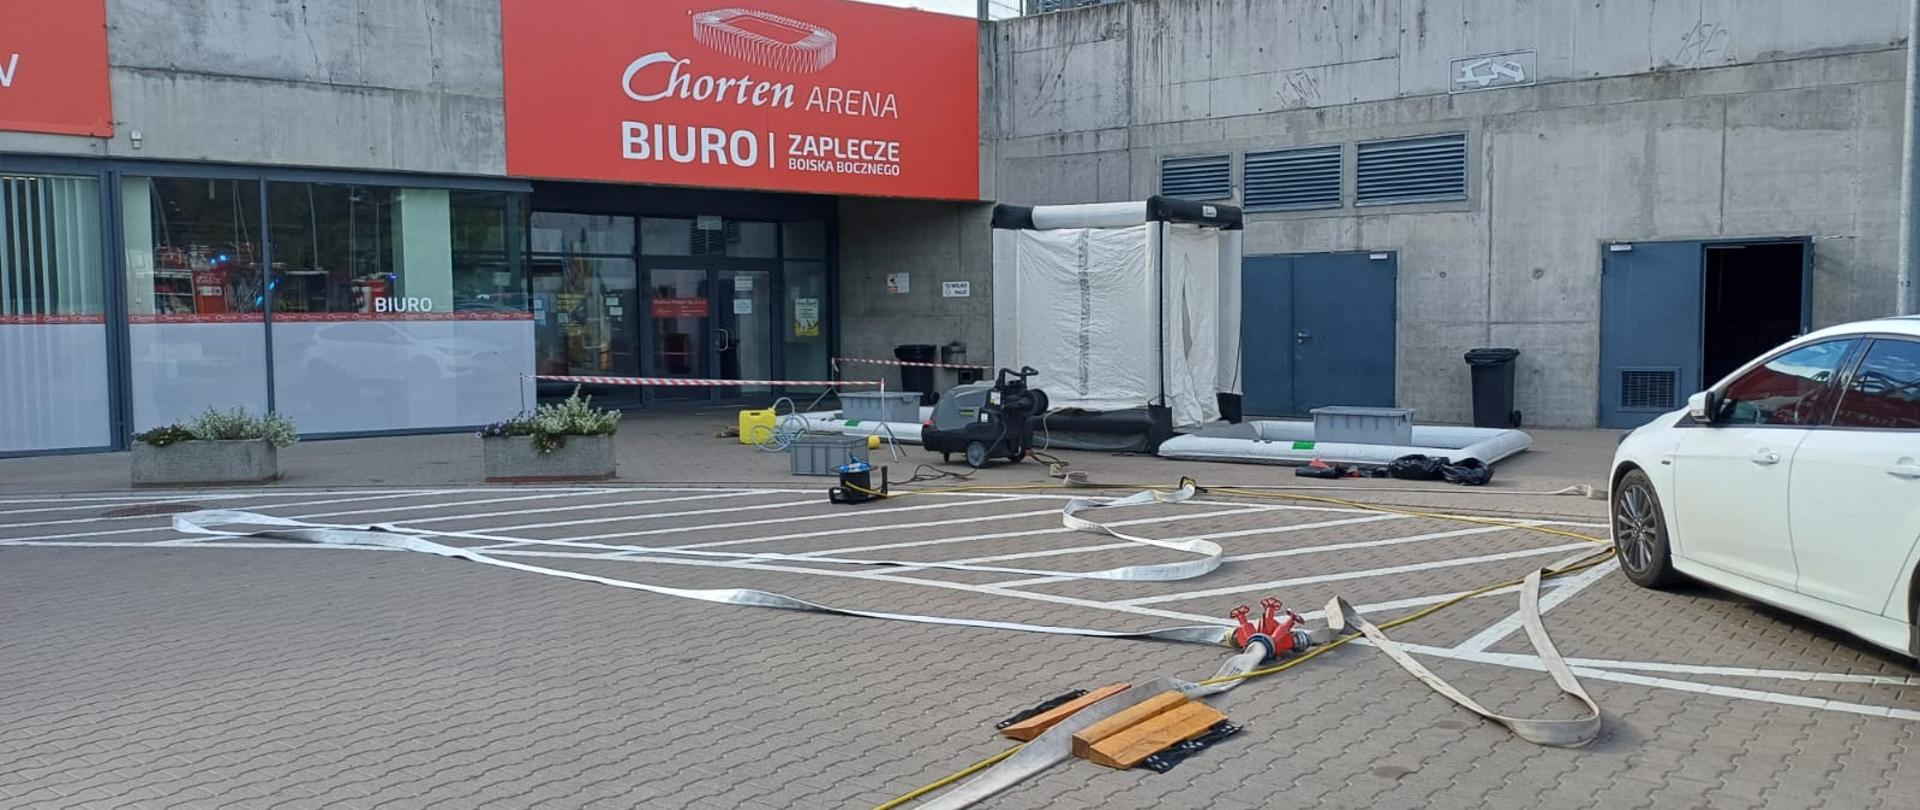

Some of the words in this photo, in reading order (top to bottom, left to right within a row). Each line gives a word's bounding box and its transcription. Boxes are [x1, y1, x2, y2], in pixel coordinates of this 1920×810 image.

[621, 51, 795, 109] Chorten
[805, 86, 899, 119] ARENA
[621, 120, 759, 168] BIURO
[787, 134, 900, 162] ZAPLECZE
[788, 157, 835, 173] BOISKA
[836, 160, 900, 176] BOCZNEGO
[375, 297, 432, 312] BIURO
